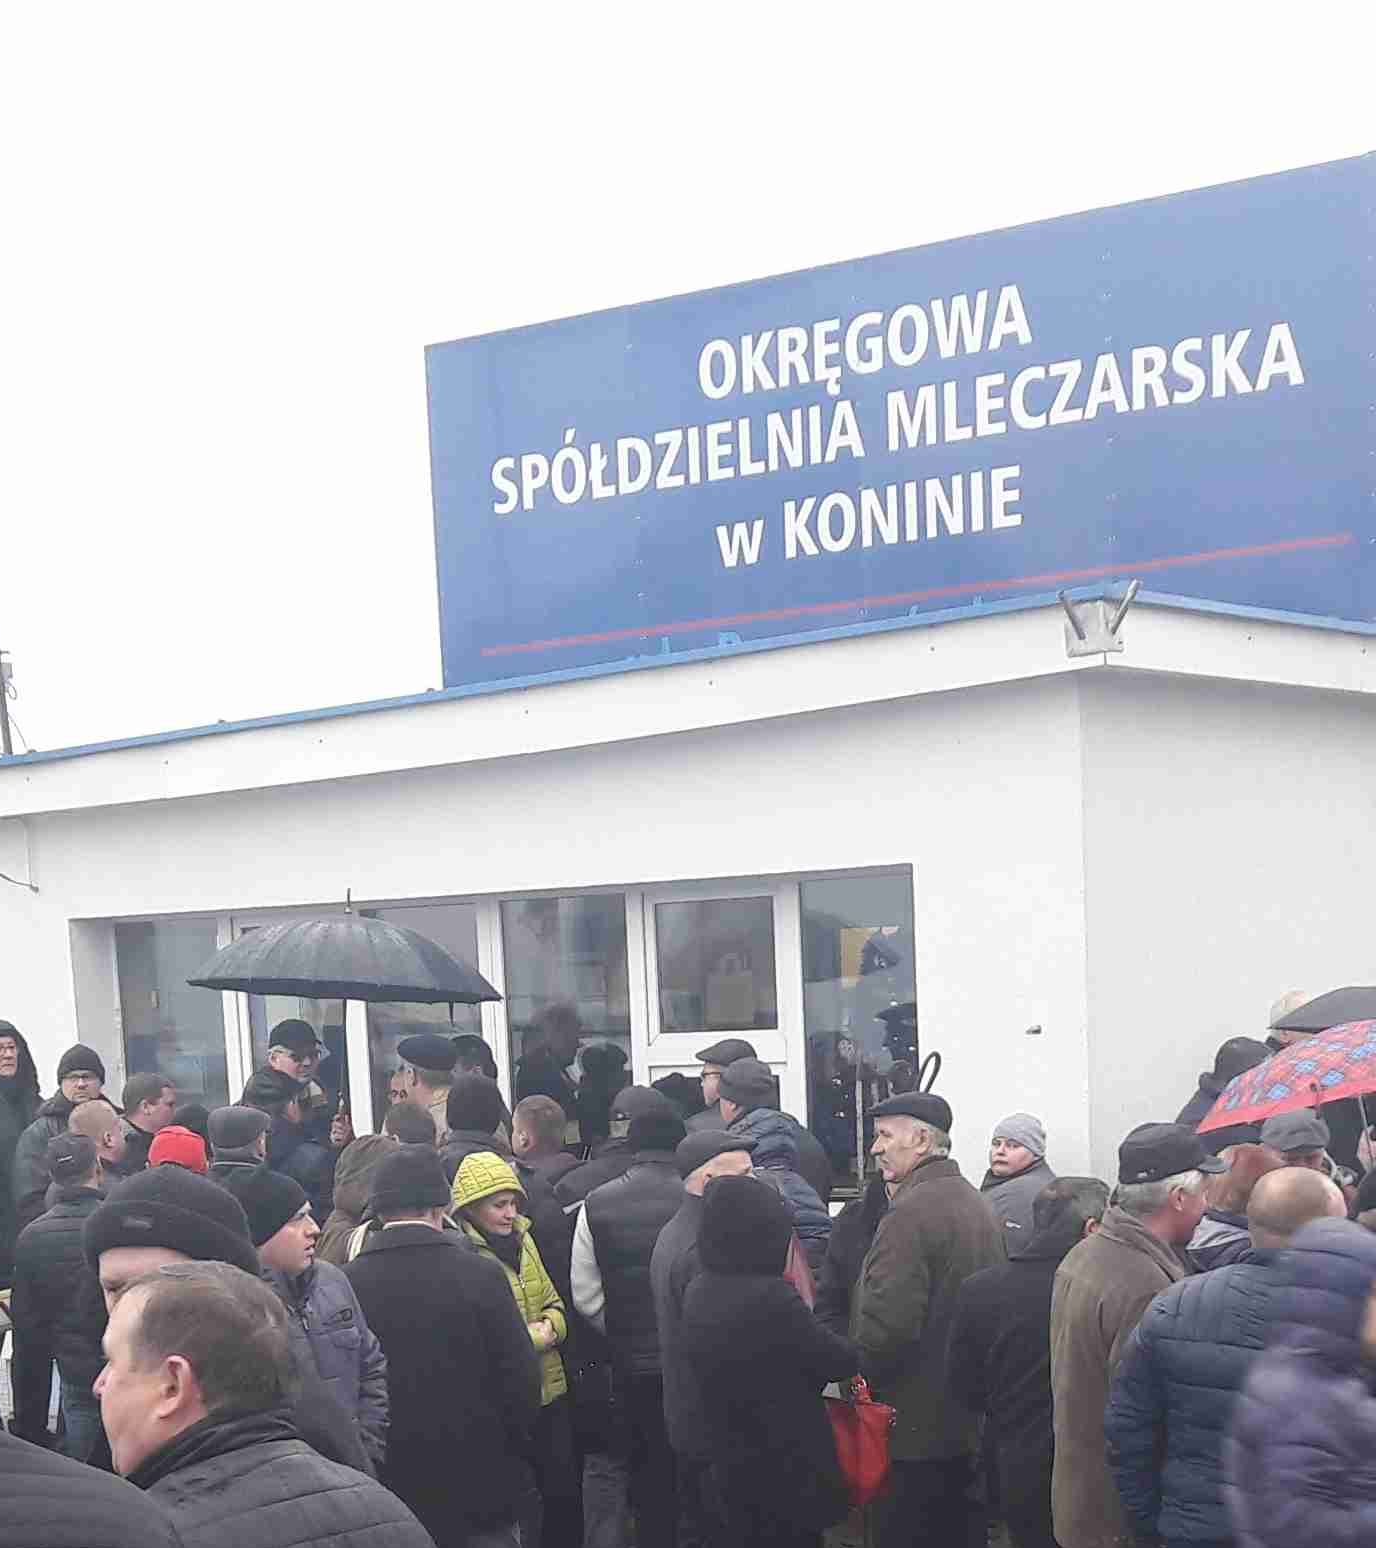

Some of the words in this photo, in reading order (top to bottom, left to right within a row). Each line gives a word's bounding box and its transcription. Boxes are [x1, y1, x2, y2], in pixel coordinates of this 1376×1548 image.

[698, 284, 1033, 396] OKRĘGOWA
[490, 399, 866, 515] SPÓŁDZIELNIA
[886, 321, 1306, 452] MLECZARSKA
[715, 518, 765, 569] w
[783, 464, 1023, 560] KONINIE
